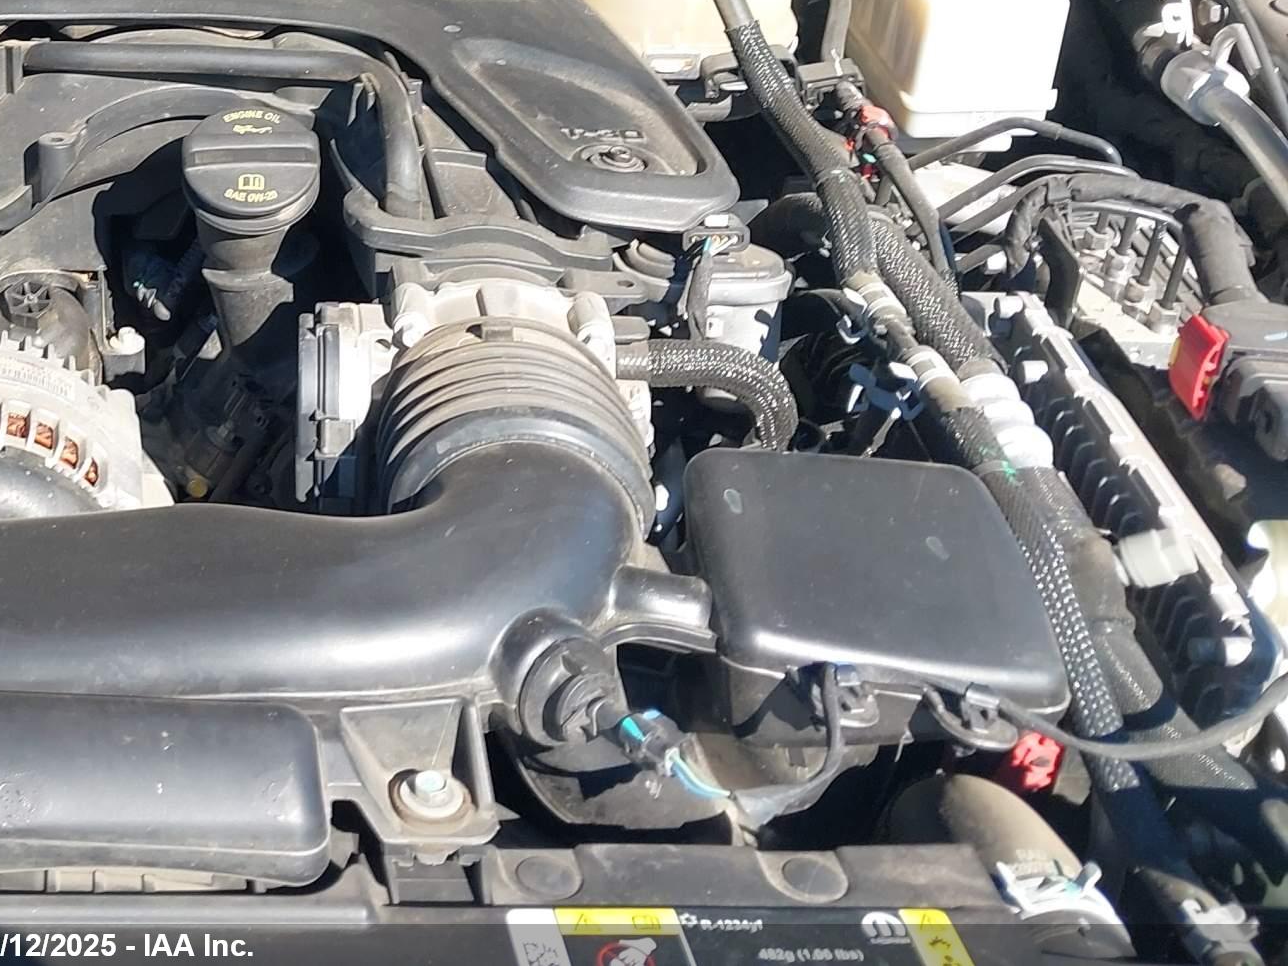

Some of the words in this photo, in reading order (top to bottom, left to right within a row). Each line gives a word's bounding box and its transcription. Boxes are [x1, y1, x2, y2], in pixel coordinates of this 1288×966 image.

[222, 110, 263, 123] ENGINE
[264, 113, 281, 124] OIL
[223, 188, 246, 202] SAE
